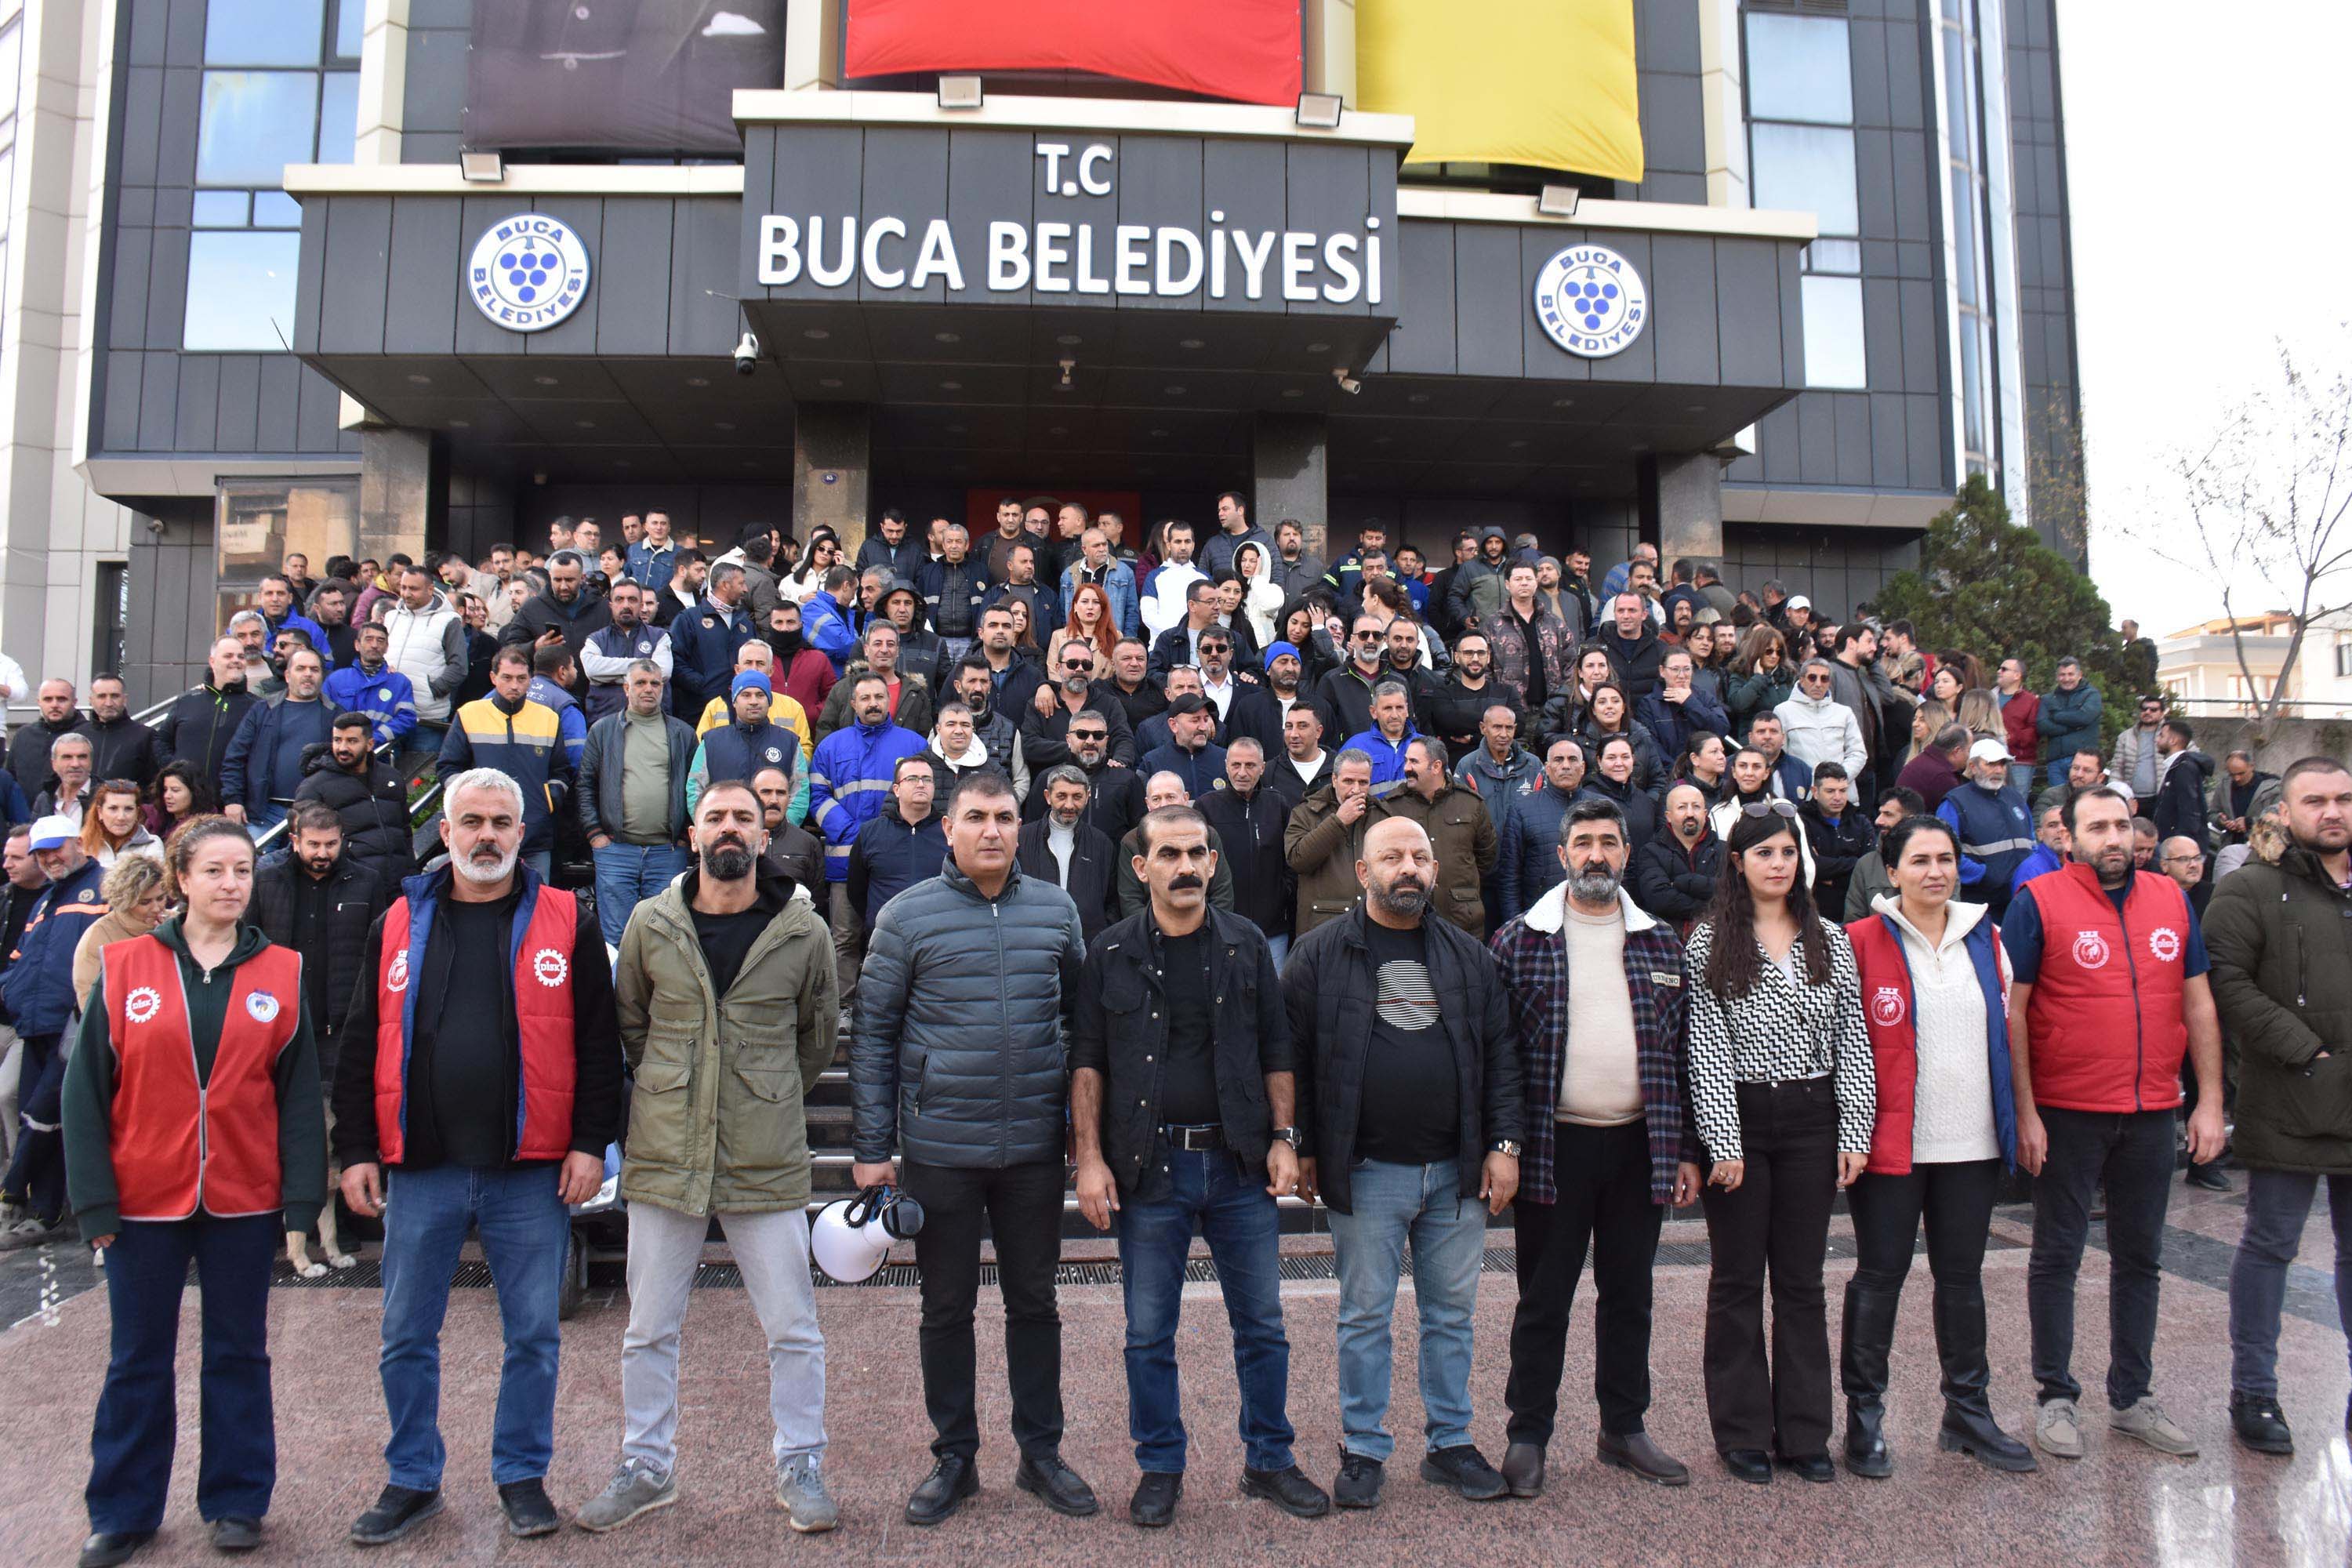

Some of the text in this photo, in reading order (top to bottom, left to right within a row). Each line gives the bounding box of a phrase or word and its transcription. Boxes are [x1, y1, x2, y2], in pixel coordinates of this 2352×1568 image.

[496, 220, 564, 242] BUCA
[757, 209, 1382, 305] BUCA BELEDİYESİ
[1559, 251, 1621, 274] BUCA
